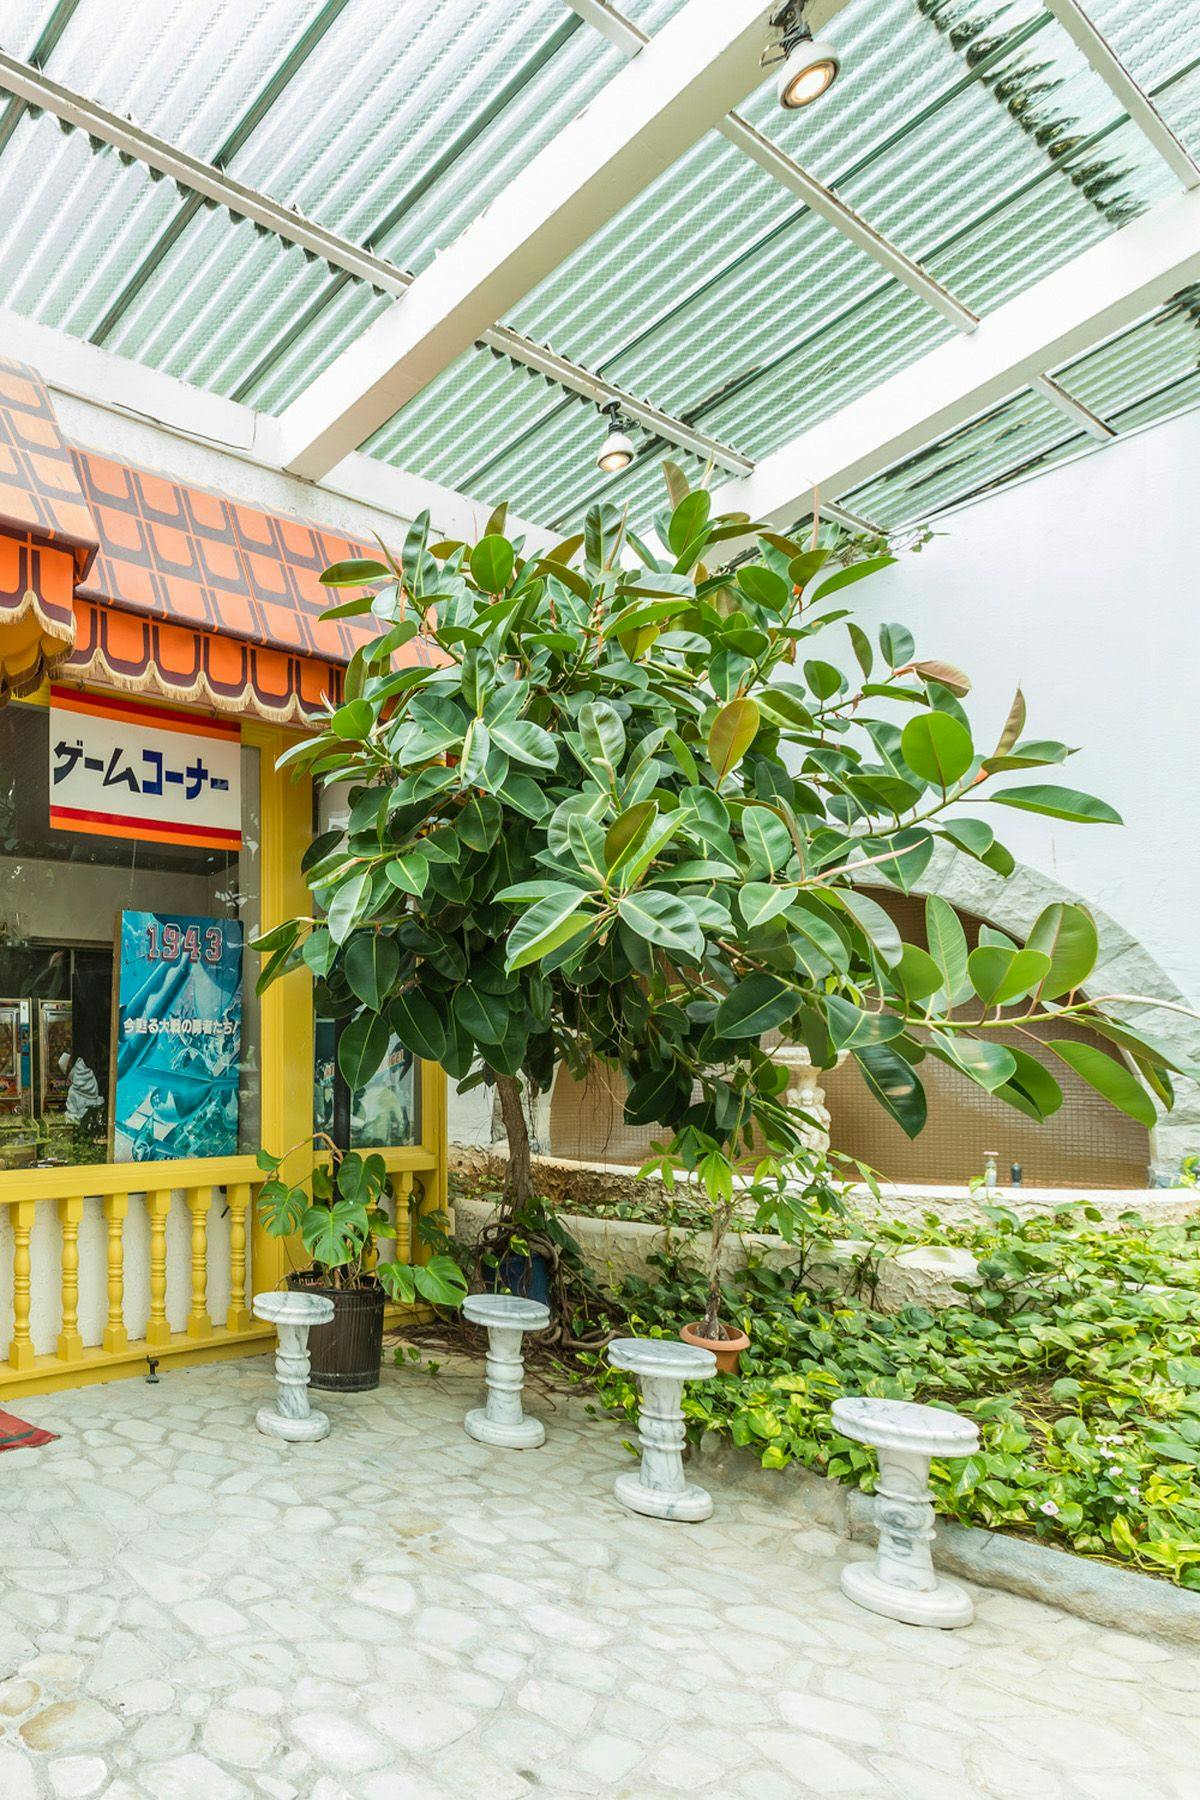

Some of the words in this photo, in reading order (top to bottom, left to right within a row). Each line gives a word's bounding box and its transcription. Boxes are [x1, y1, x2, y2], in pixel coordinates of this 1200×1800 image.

[54, 739, 229, 800] ゲームコーナー
[146, 922, 223, 964] 1943
